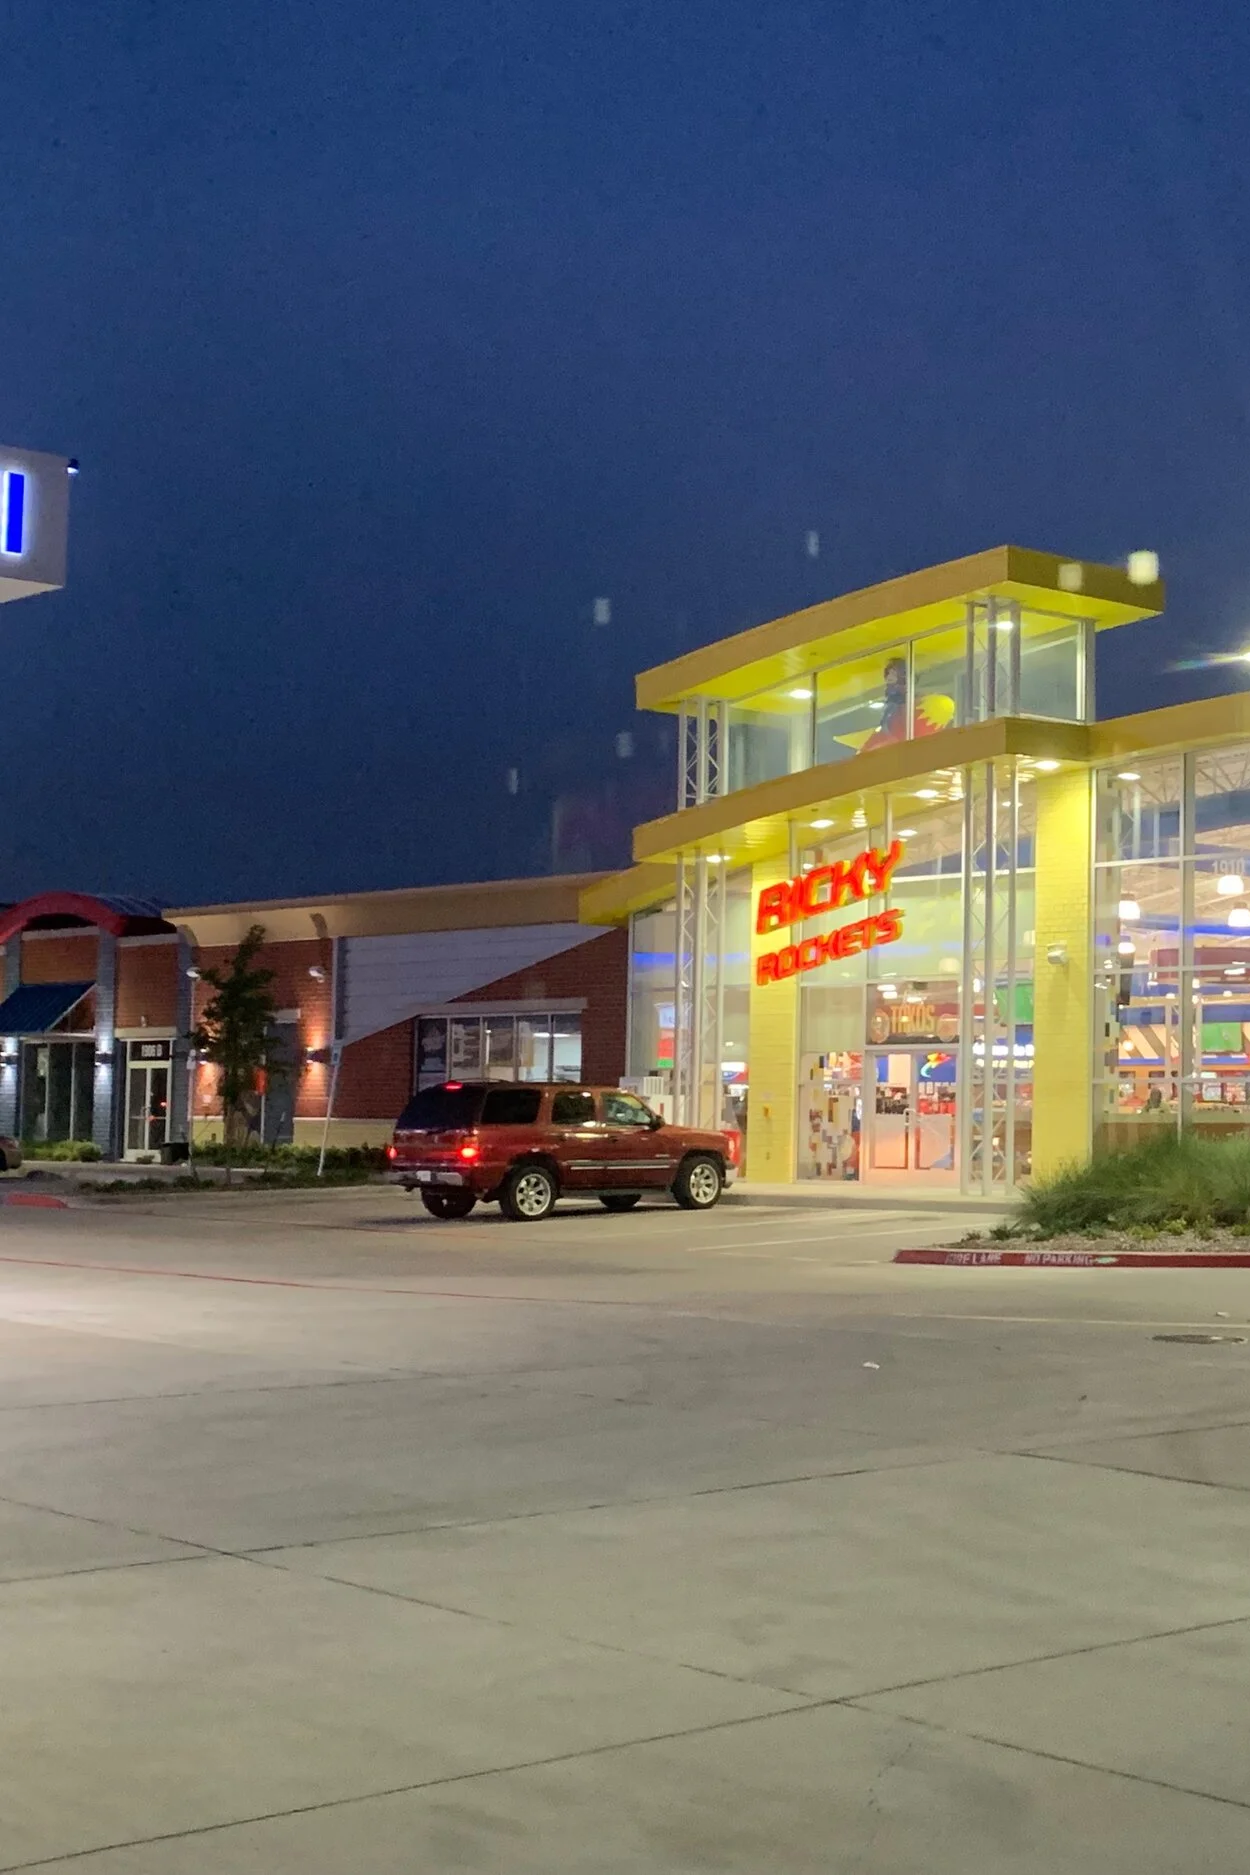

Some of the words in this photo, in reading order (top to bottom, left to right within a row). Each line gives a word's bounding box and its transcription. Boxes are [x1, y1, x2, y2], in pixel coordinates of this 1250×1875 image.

[757, 840, 903, 935] RICKY
[757, 908, 904, 986] ROCKETS
[972, 1252, 1002, 1265] LANE
[1024, 1253, 1041, 1265] NO
[1042, 1253, 1092, 1266] PARKING
